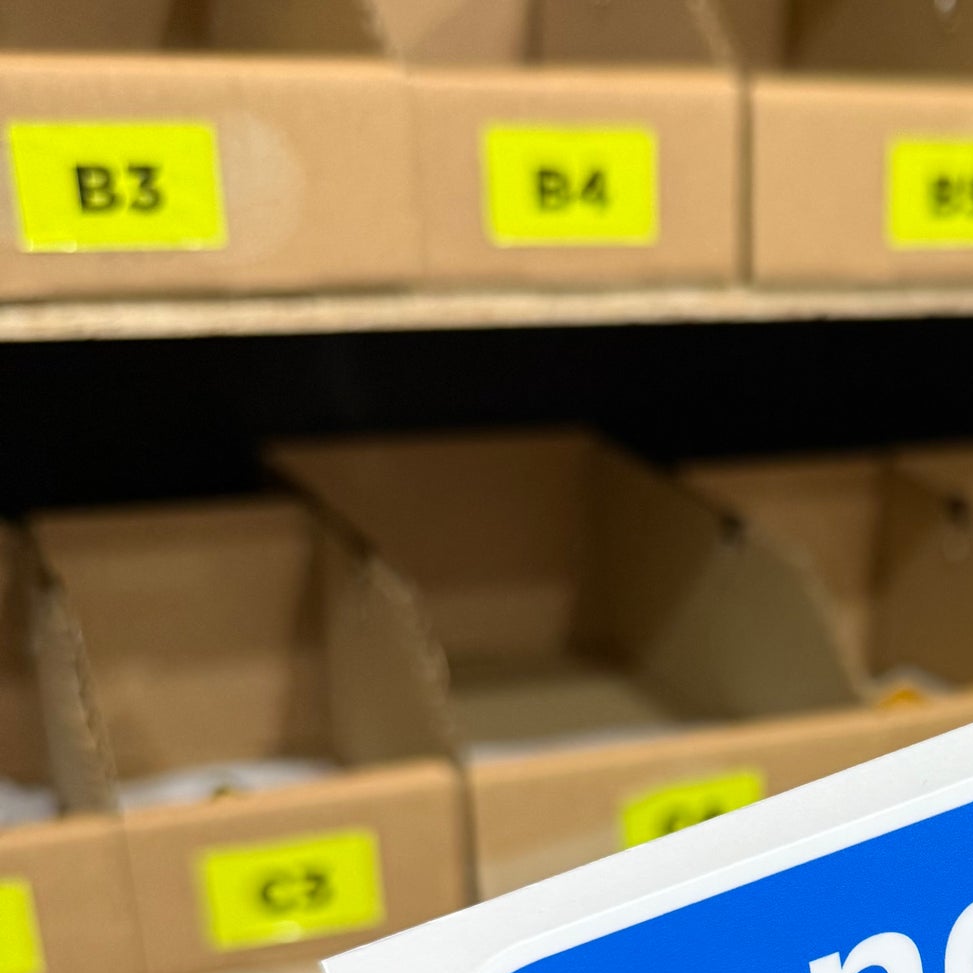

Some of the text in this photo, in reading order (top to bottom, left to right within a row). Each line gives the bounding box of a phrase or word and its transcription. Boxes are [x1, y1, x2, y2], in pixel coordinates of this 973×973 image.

[73, 163, 163, 213] B3
[533, 168, 609, 213] B4
[257, 865, 336, 914] C3
